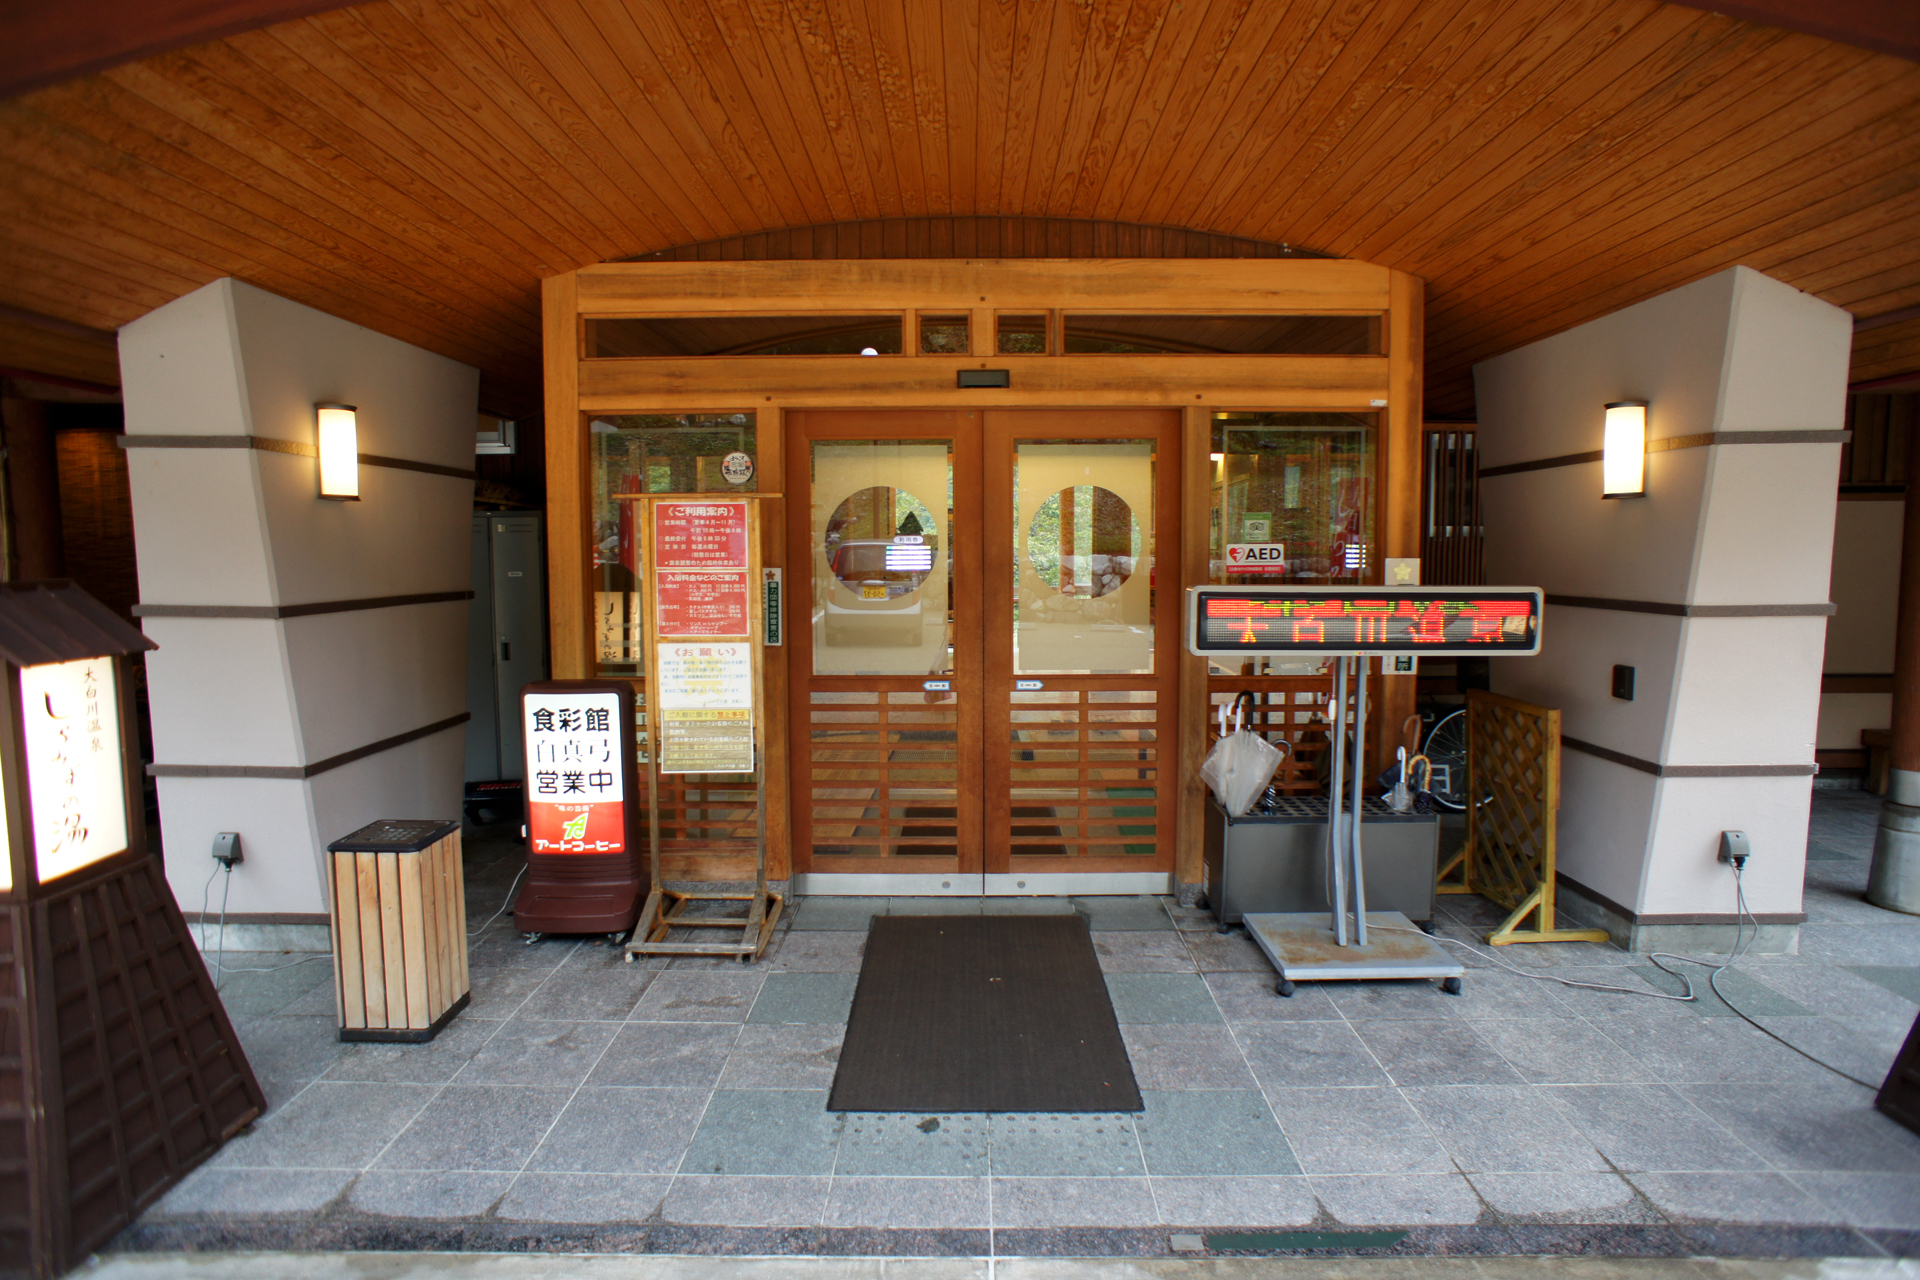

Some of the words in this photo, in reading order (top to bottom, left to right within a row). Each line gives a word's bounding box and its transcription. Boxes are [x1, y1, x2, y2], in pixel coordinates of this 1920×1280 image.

[1245, 548, 1281, 560] AED
[83, 666, 103, 753] 大白川温泉
[532, 707, 610, 733] 食彩館
[536, 739, 612, 763] 白真弓
[44, 690, 89, 854] しらみずの湯
[536, 769, 613, 794] 営業中
[535, 839, 621, 852] アートコーヒー
